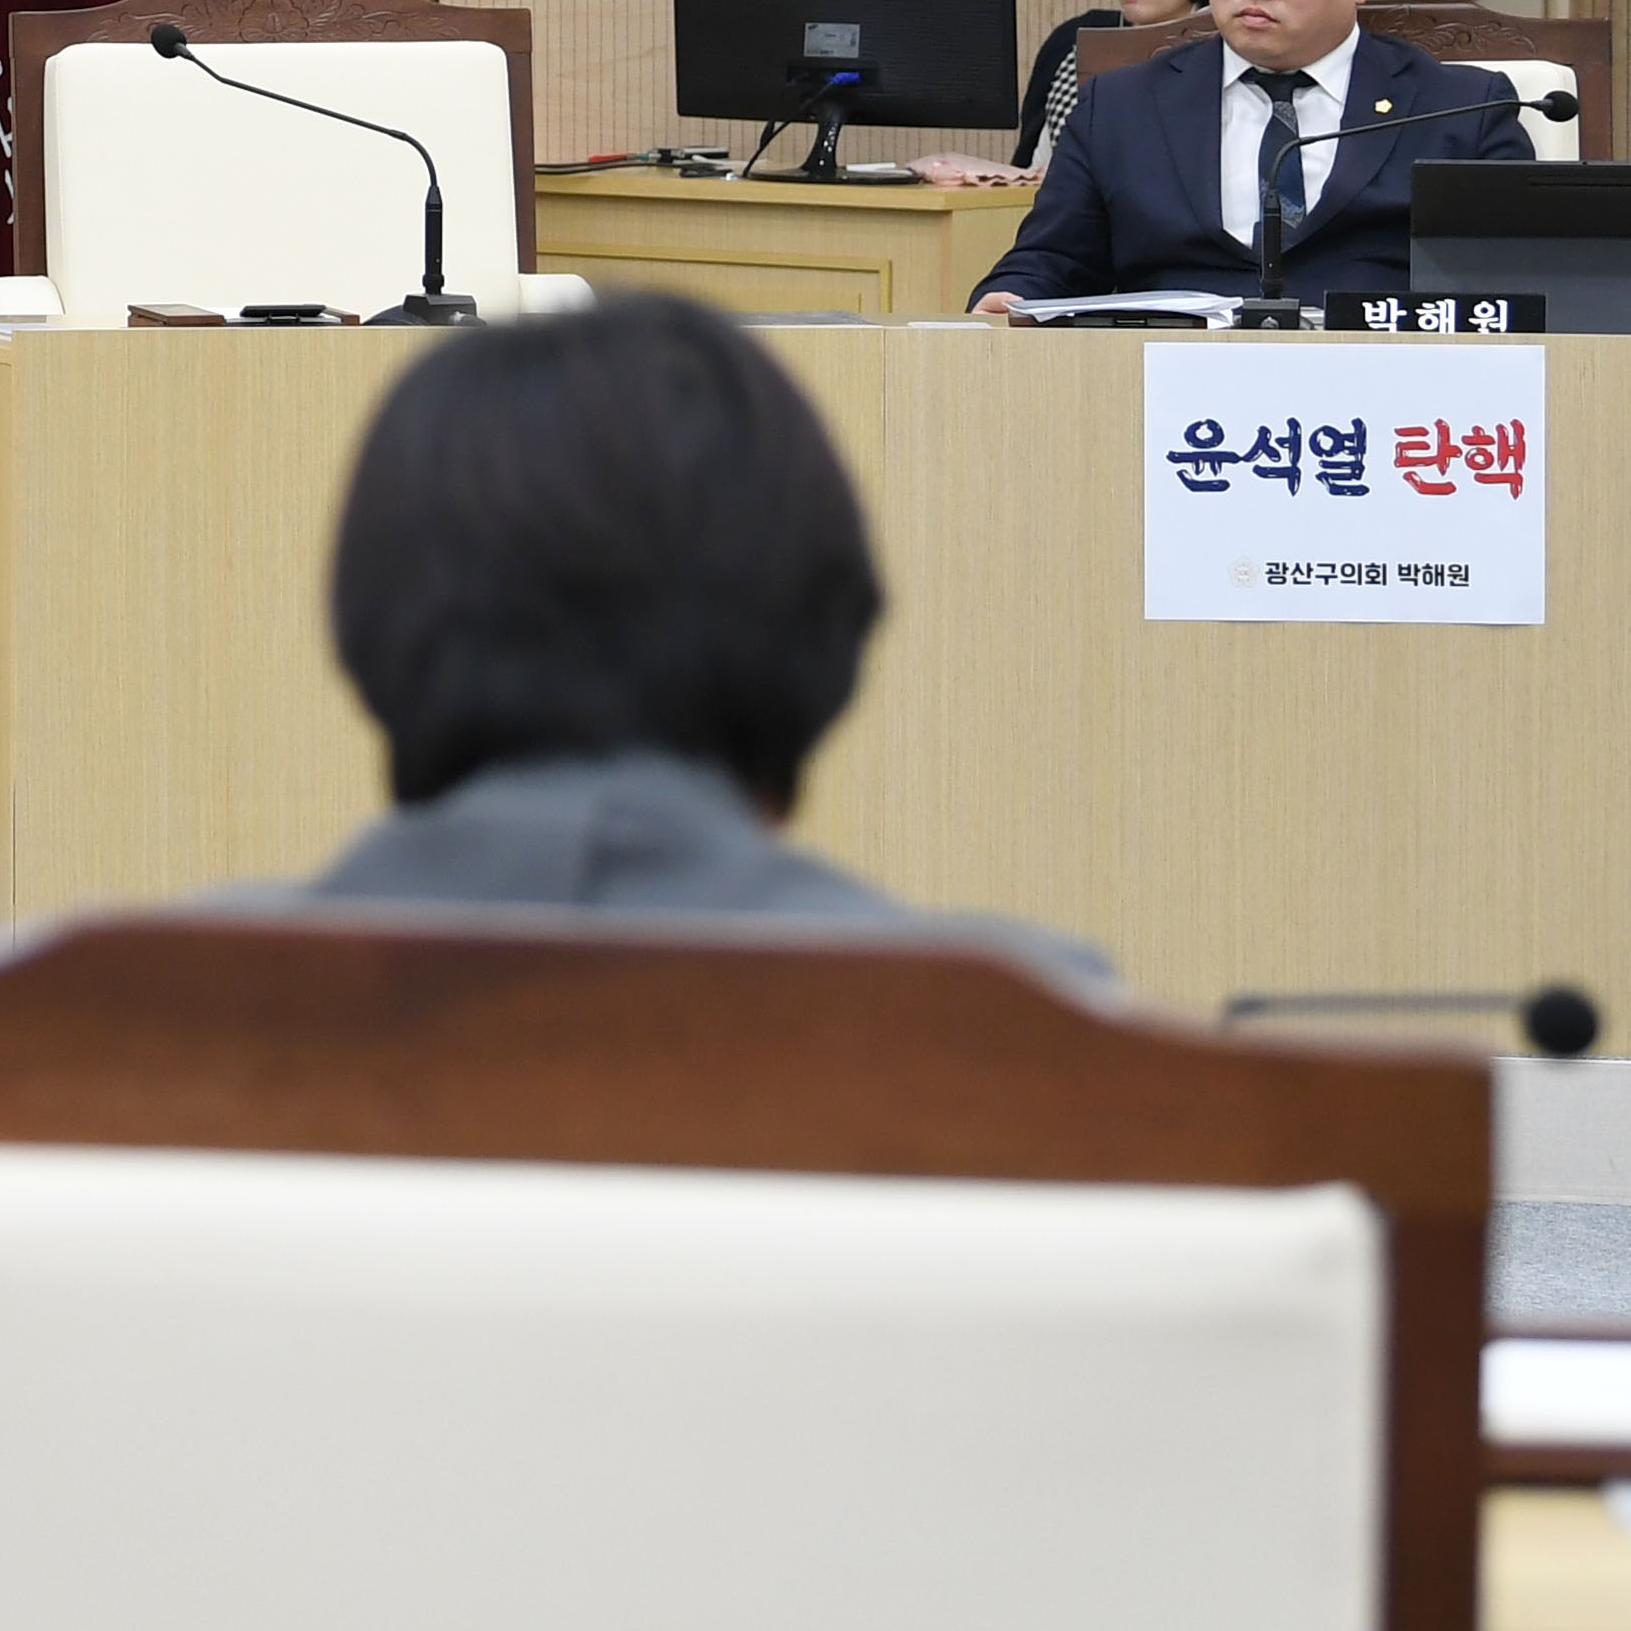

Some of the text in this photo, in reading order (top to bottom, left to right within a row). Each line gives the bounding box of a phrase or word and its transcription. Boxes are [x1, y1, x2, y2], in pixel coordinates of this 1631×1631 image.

[1166, 417, 1527, 500] 윤석열 탄핵
[1264, 562, 1470, 588] 광산구의회 박해원
